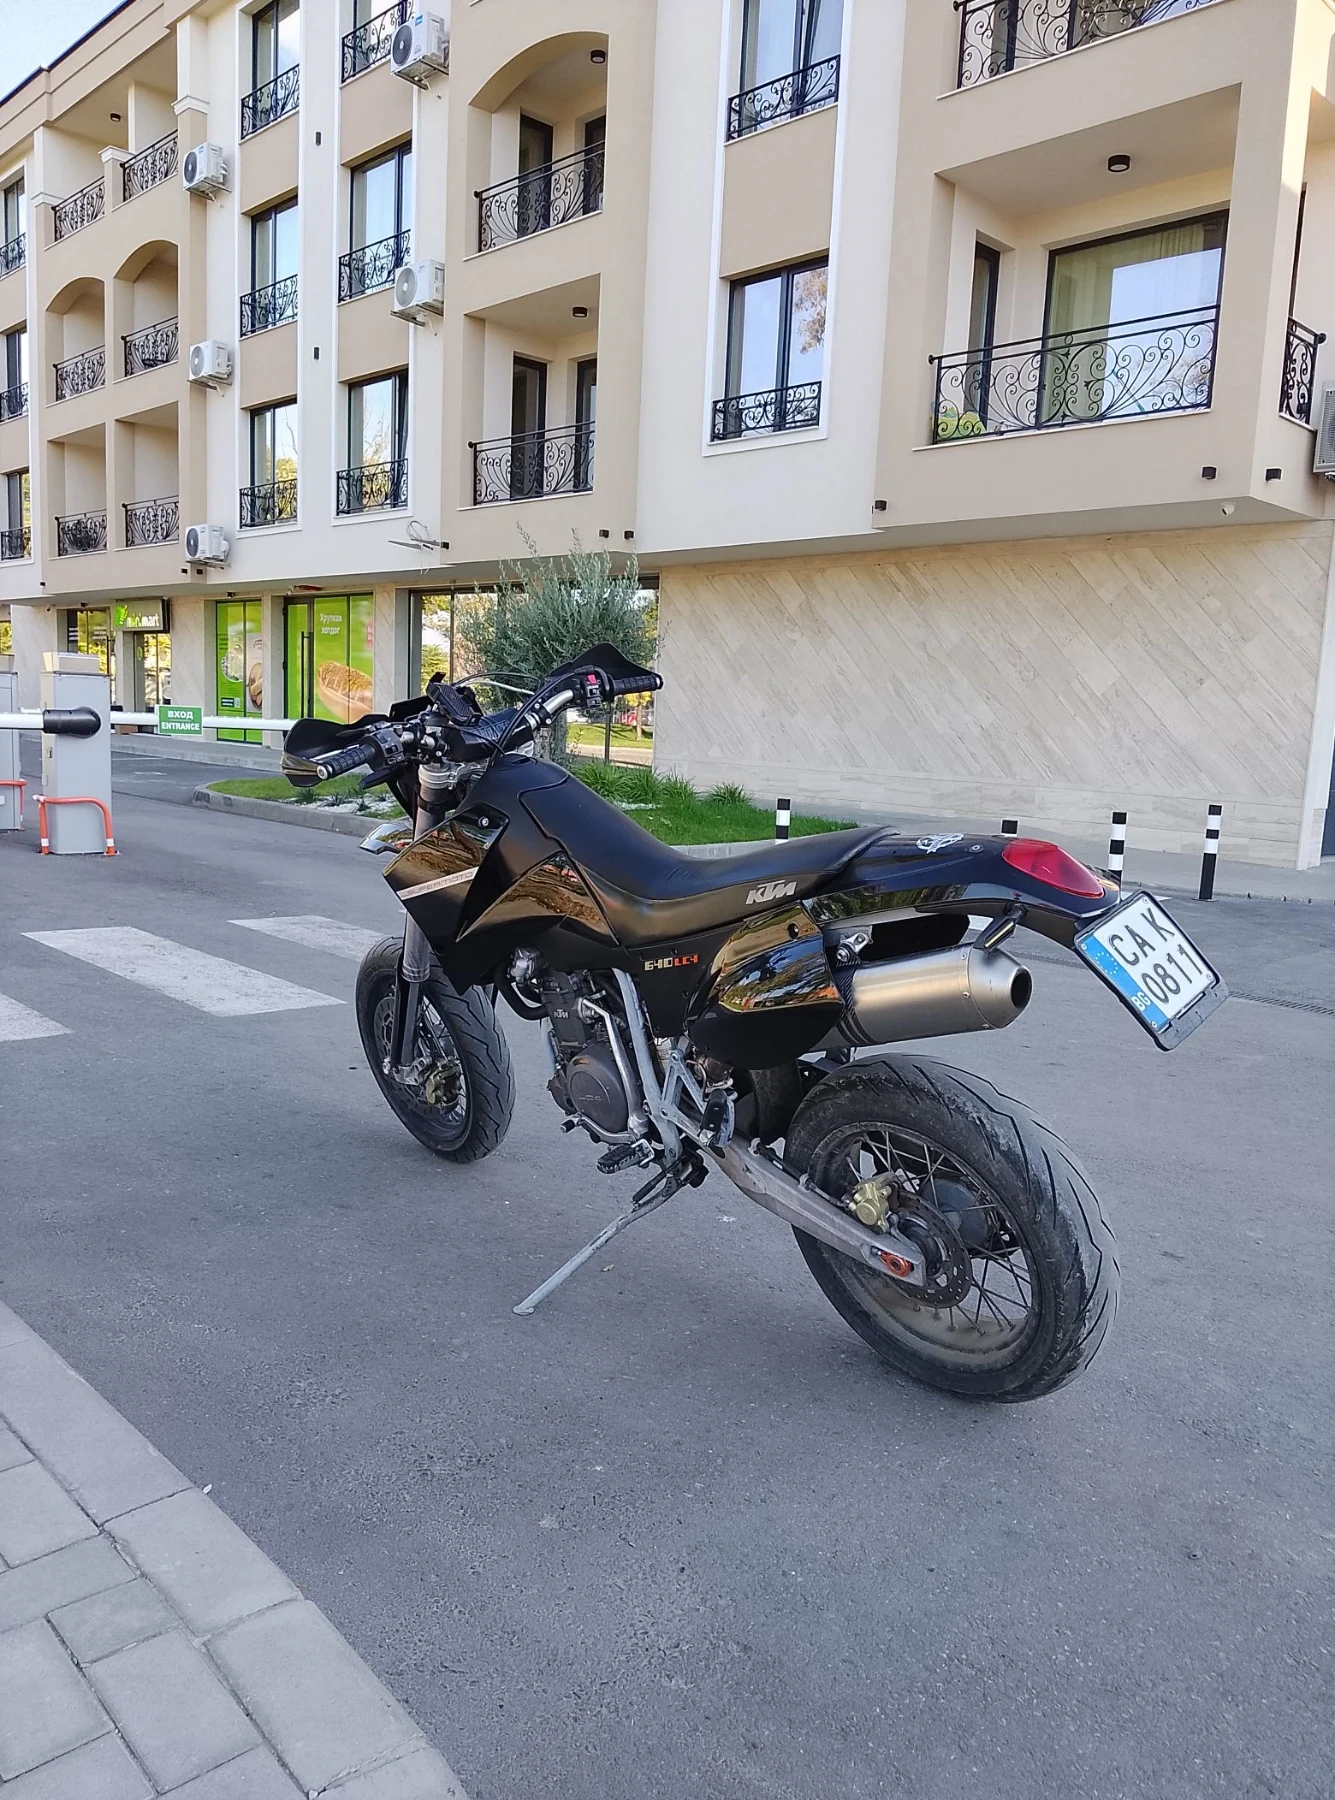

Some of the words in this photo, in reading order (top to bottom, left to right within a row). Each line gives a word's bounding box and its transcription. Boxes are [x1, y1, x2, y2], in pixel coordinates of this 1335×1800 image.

[167, 710, 194, 720] ВХОД
[161, 721, 200, 731] ENTRANCE
[402, 871, 474, 897] SUPERMOTO
[745, 879, 797, 905] KTM
[1141, 943, 1203, 1005] 0811
[1130, 991, 1151, 1012] BG
[553, 1009, 569, 1019] KTM
